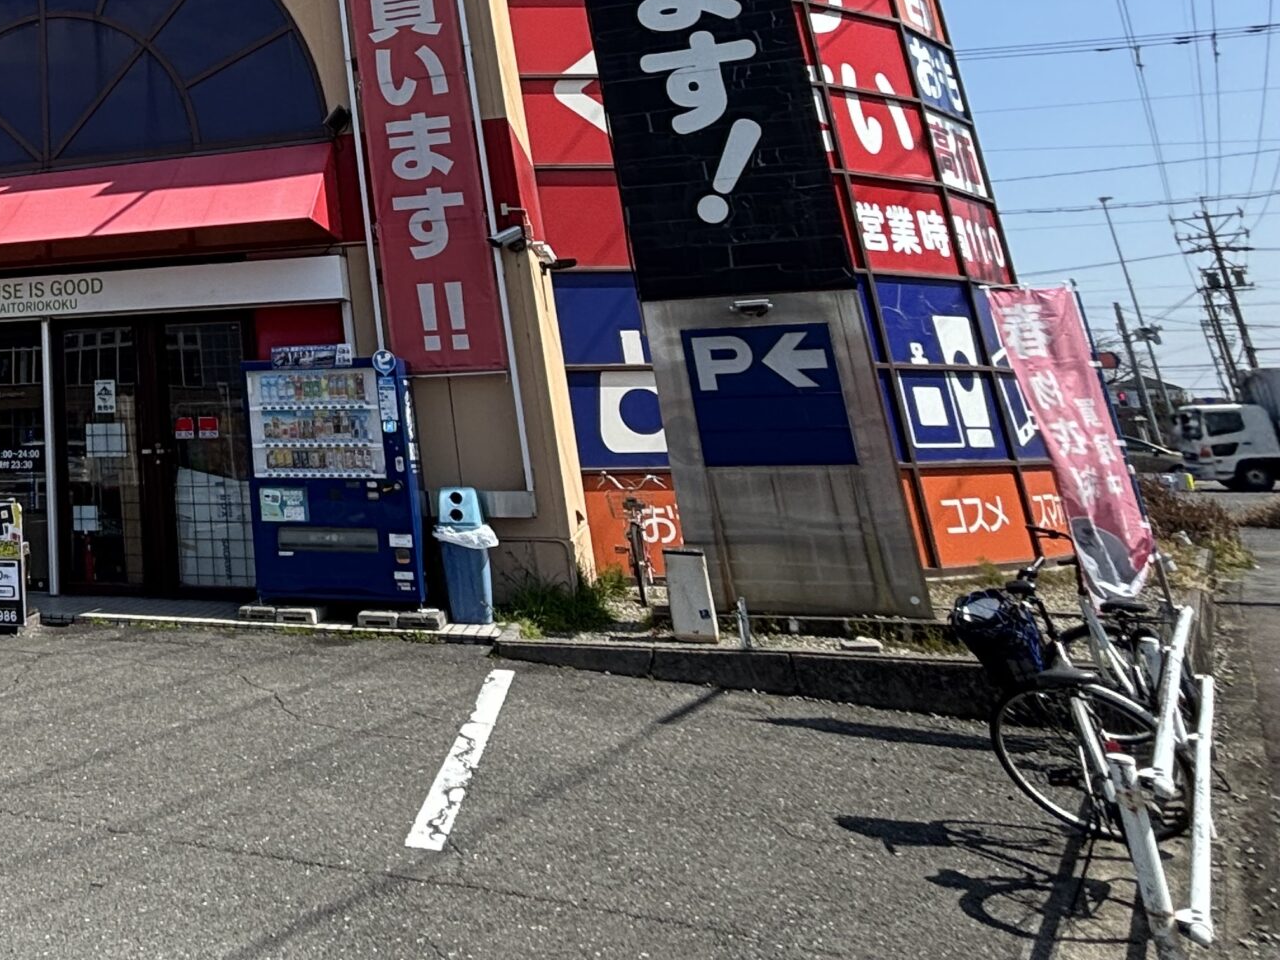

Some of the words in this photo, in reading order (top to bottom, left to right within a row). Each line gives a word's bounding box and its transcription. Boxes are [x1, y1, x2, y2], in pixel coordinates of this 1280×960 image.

[29, 281, 45, 299] IS
[50, 277, 104, 297] GOOD
[690, 335, 754, 392] P
[10, 460, 33, 469] 23:30
[939, 495, 1010, 535] コスメ
